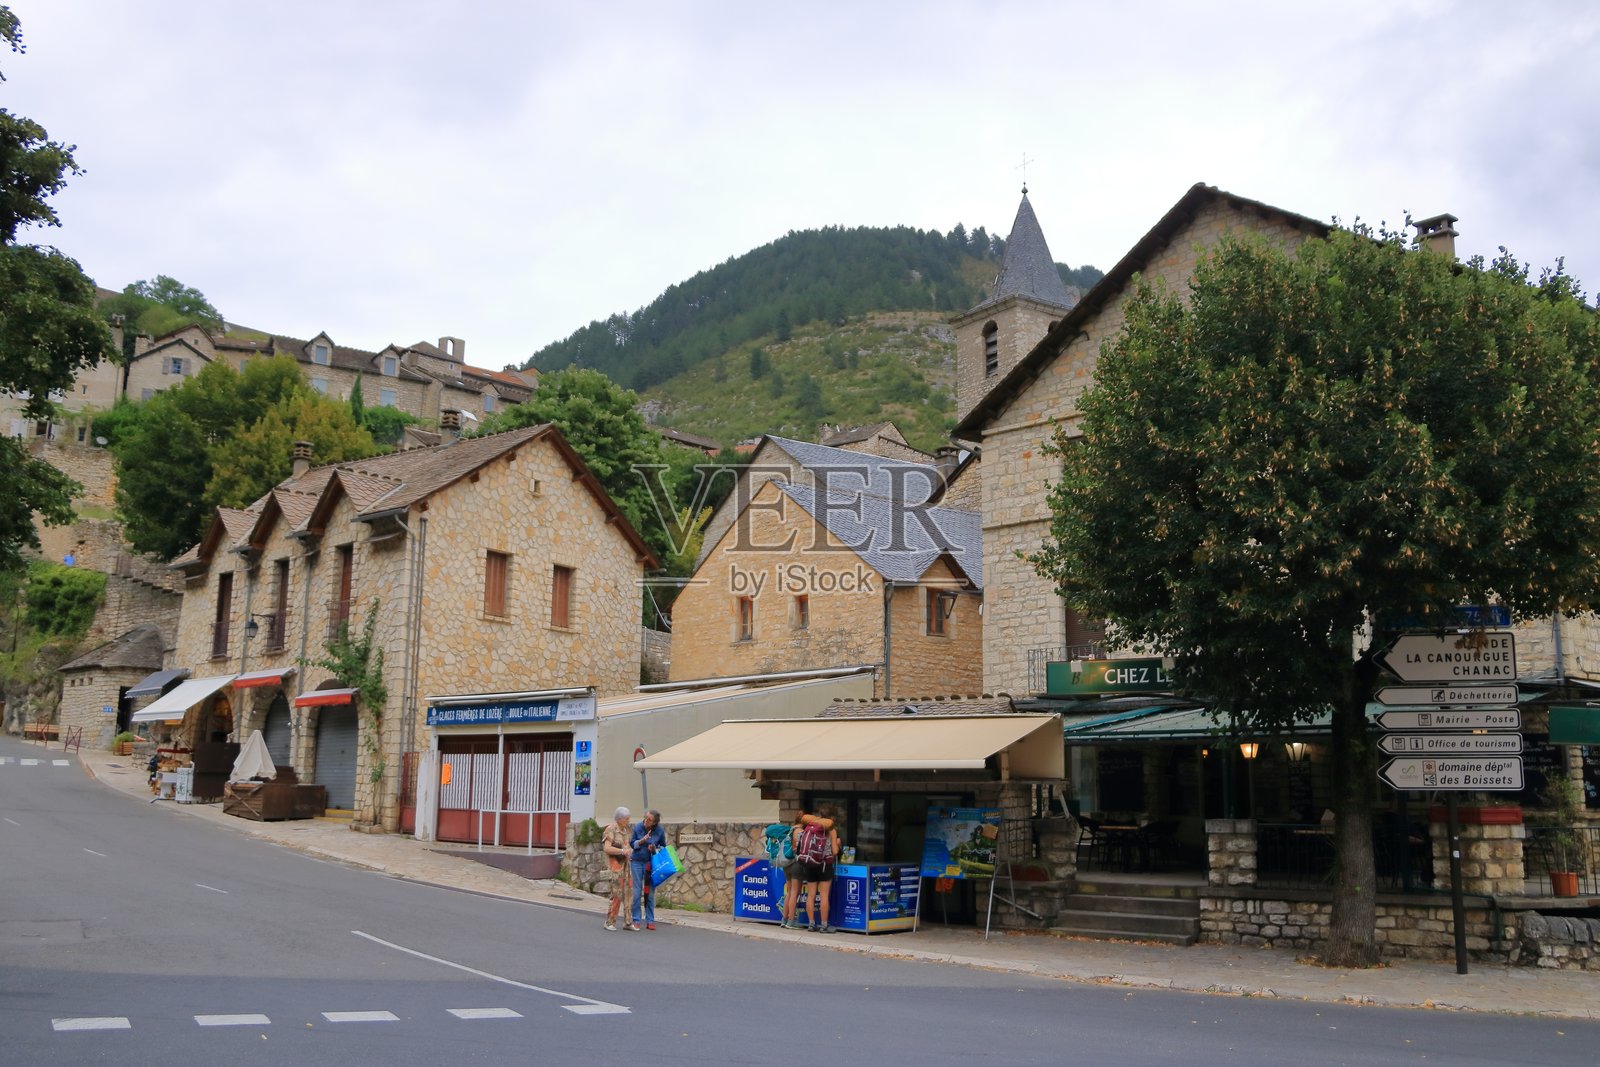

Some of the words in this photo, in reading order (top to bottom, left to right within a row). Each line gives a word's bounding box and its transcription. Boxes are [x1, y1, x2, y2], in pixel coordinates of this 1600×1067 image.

[1406, 653, 1421, 663] LA
[1453, 665, 1510, 676] CHANAC
[1104, 667, 1150, 685] CHEZ
[1449, 690, 1512, 700] Déchetterie
[479, 707, 486, 719] DE
[1435, 715, 1470, 724] Mairie
[1485, 715, 1515, 723] Poste
[1428, 739, 1457, 748] Office
[1460, 739, 1471, 748] de
[1475, 739, 1517, 748] tourisme
[1438, 762, 1482, 772] domaine
[1440, 775, 1459, 785] des
[1463, 775, 1513, 785] Boissets
[742, 874, 769, 885] Canoë
[742, 887, 769, 899] Kayak
[742, 902, 771, 913] Paddle
